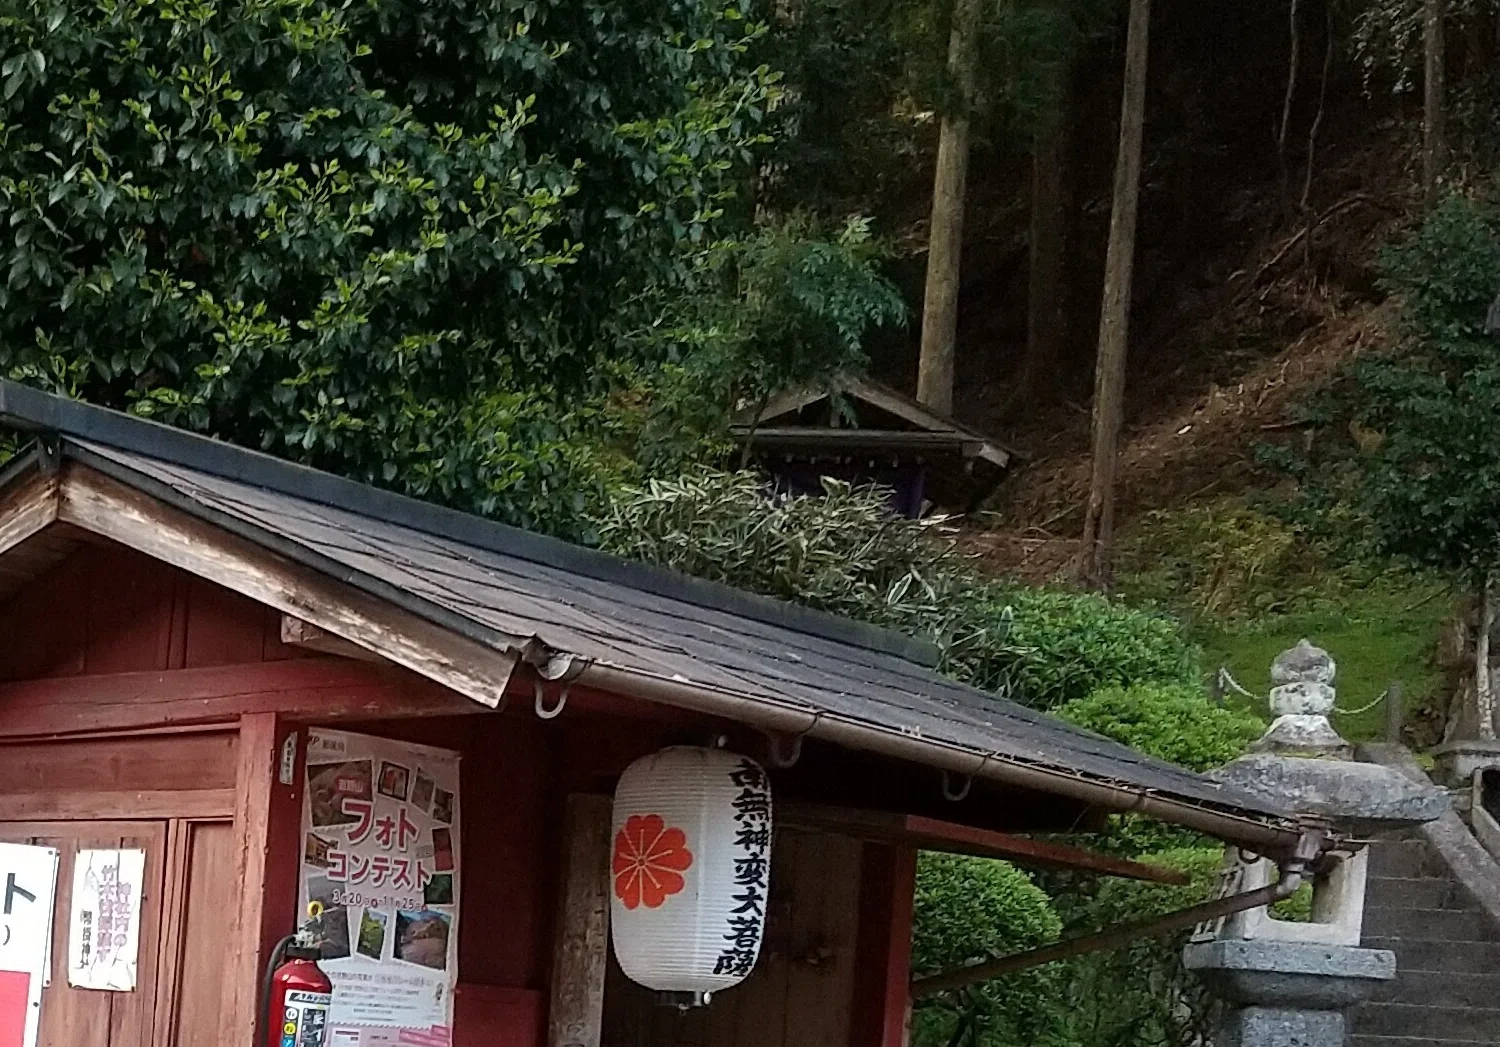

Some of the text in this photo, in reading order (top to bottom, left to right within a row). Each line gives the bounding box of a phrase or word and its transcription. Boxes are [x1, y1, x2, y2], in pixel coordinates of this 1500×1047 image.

[342, 798, 419, 852] フォト
[327, 849, 432, 890] コンテスト
